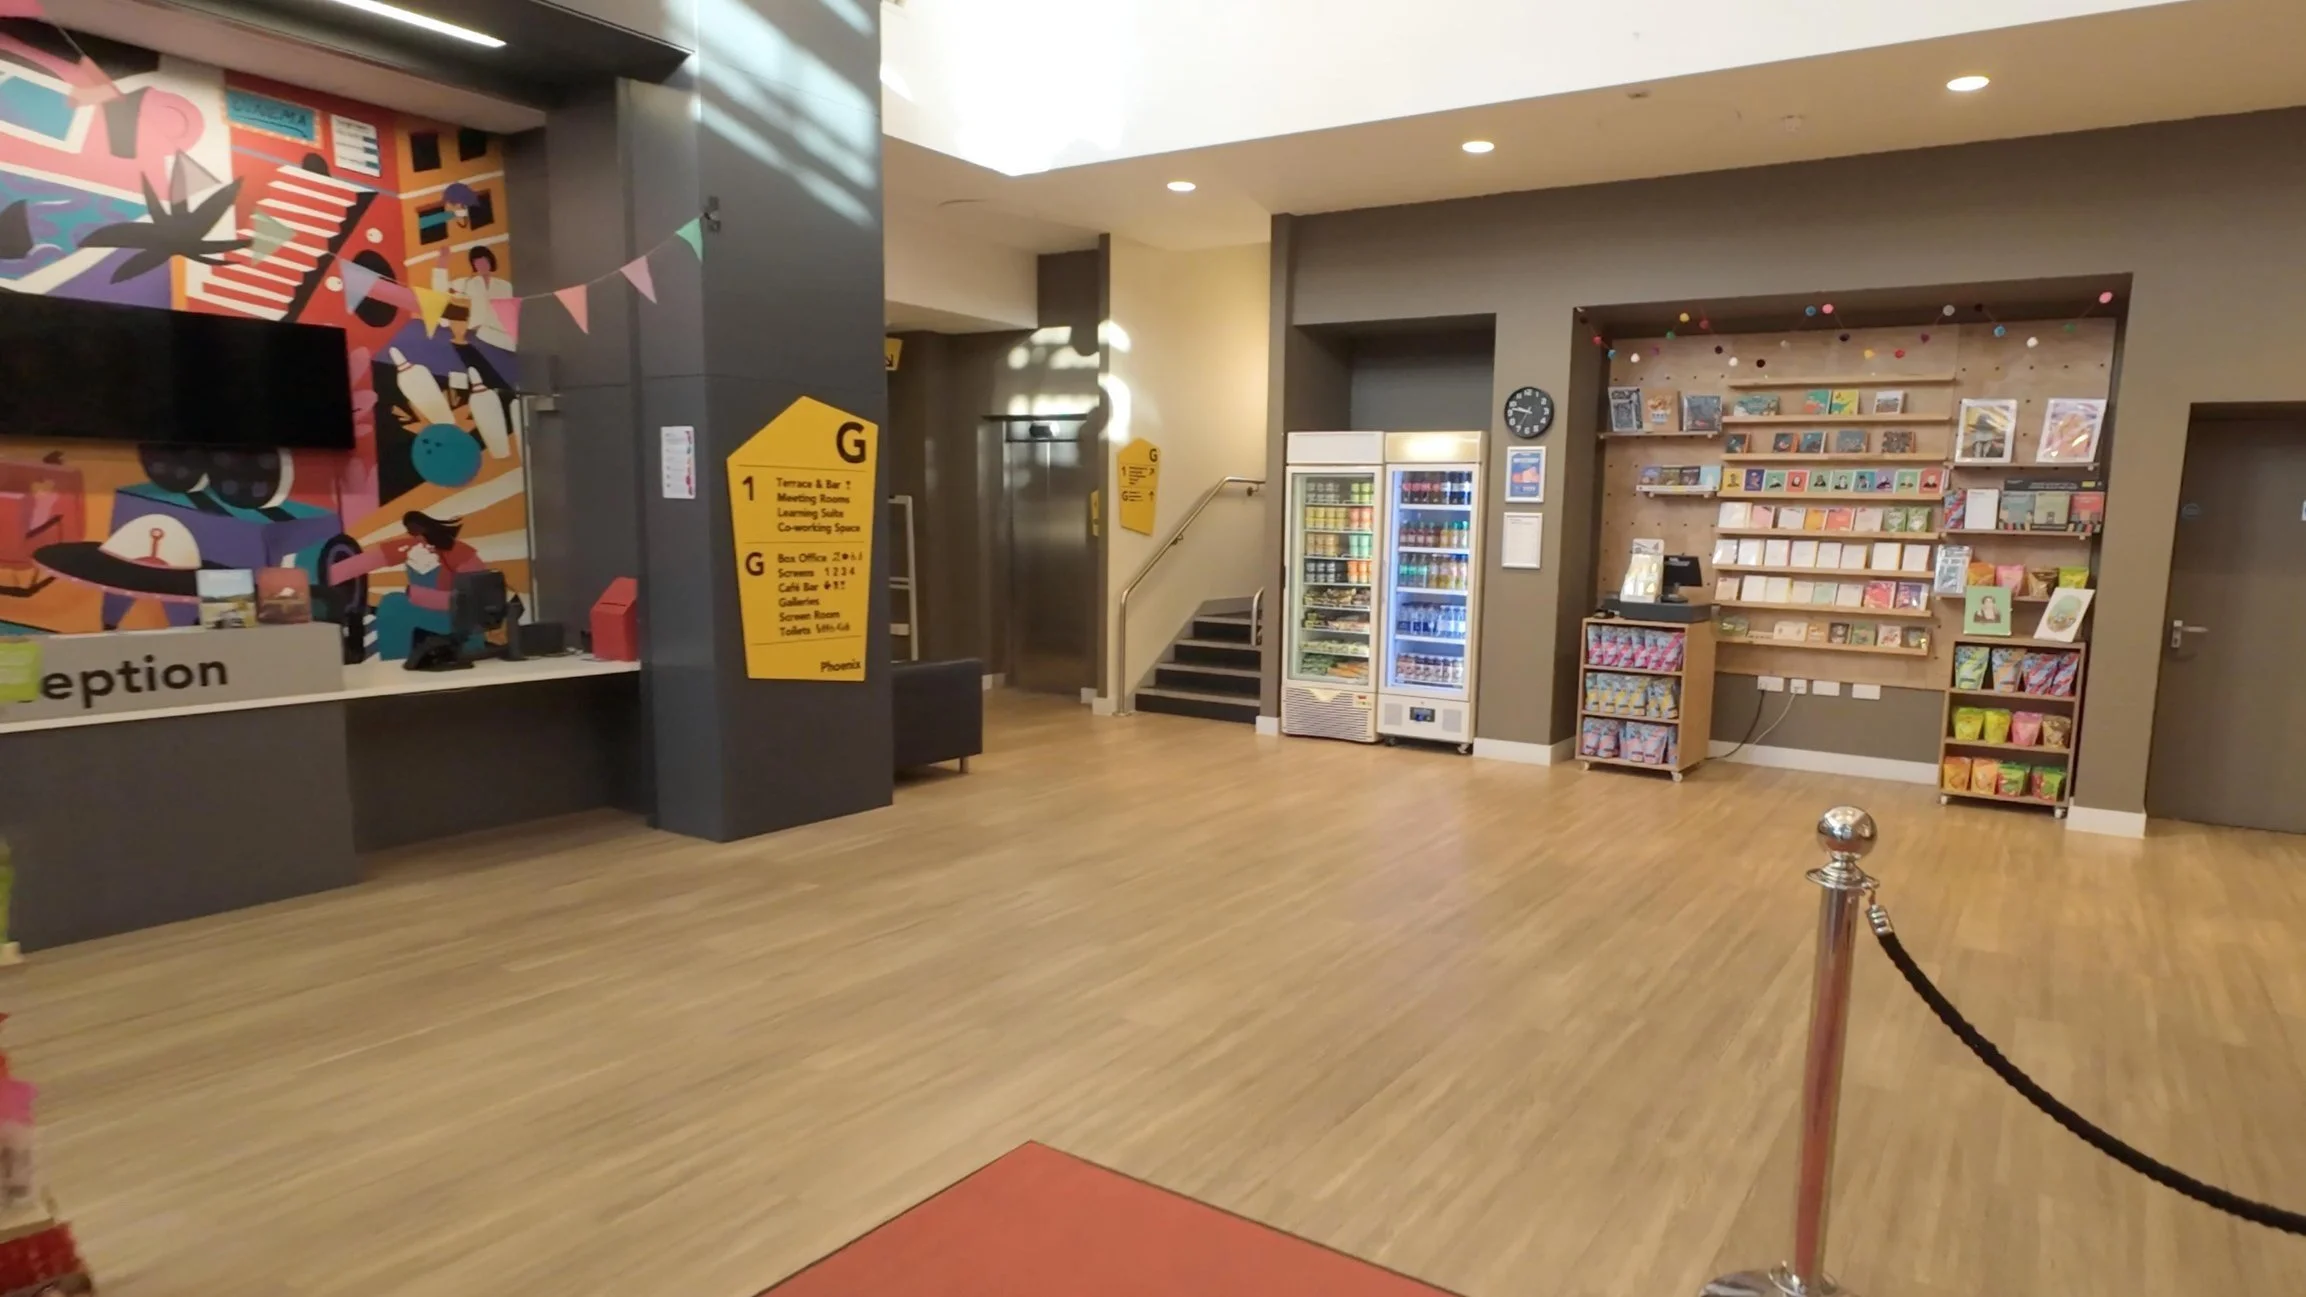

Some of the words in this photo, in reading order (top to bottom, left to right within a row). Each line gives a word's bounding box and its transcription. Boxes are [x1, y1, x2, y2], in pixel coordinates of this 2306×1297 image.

[836, 421, 867, 464] G
[1149, 448, 1158, 462] G
[742, 475, 754, 501] 1
[776, 477, 812, 489] Terrace
[816, 479, 822, 488] &
[826, 480, 841, 489] Bar
[777, 493, 816, 505] Meeting
[820, 494, 850, 503] Rooms
[1122, 491, 1128, 501] G
[777, 507, 819, 520] Learning
[821, 508, 843, 518] Suite
[777, 522, 832, 535] Co-working
[834, 523, 860, 534] Space
[777, 553, 796, 564] Box
[798, 552, 827, 564] Office
[745, 552, 765, 577] G
[778, 568, 814, 578] Screens
[833, 567, 839, 576] 2
[849, 567, 855, 575] 4
[778, 582, 801, 593] Café
[802, 582, 819, 592] Bar
[779, 597, 820, 608] Galleries
[778, 611, 811, 622] Screen
[814, 610, 840, 619] Room
[779, 625, 811, 637] Toilets
[820, 660, 861, 672] Phoenix
[40, 654, 229, 709] eption
